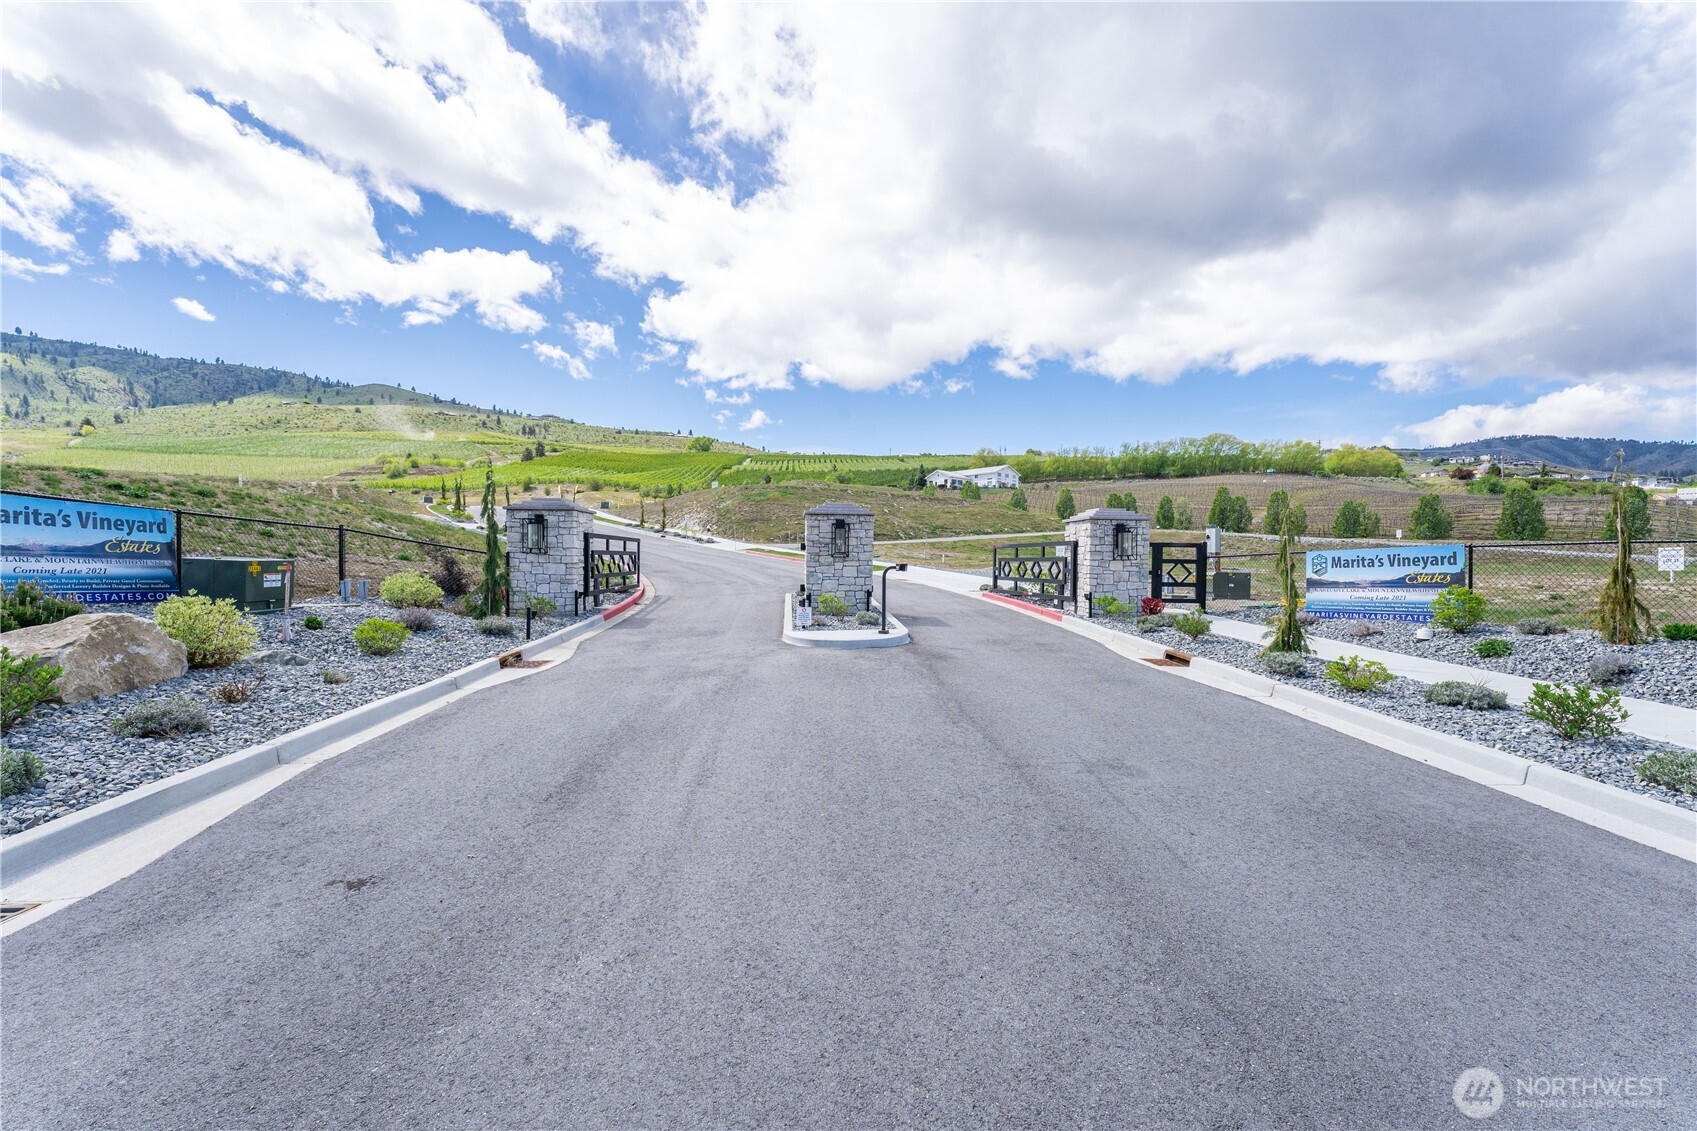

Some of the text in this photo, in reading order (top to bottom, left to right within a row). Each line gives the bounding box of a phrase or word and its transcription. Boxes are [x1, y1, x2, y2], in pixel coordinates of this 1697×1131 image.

[76, 510, 167, 536] Vineyard
[105, 535, 161, 554] Estates
[1331, 551, 1457, 570] Marita's Vineyard
[13, 566, 107, 576] Coming Late 2021
[1405, 570, 1451, 584] Estates
